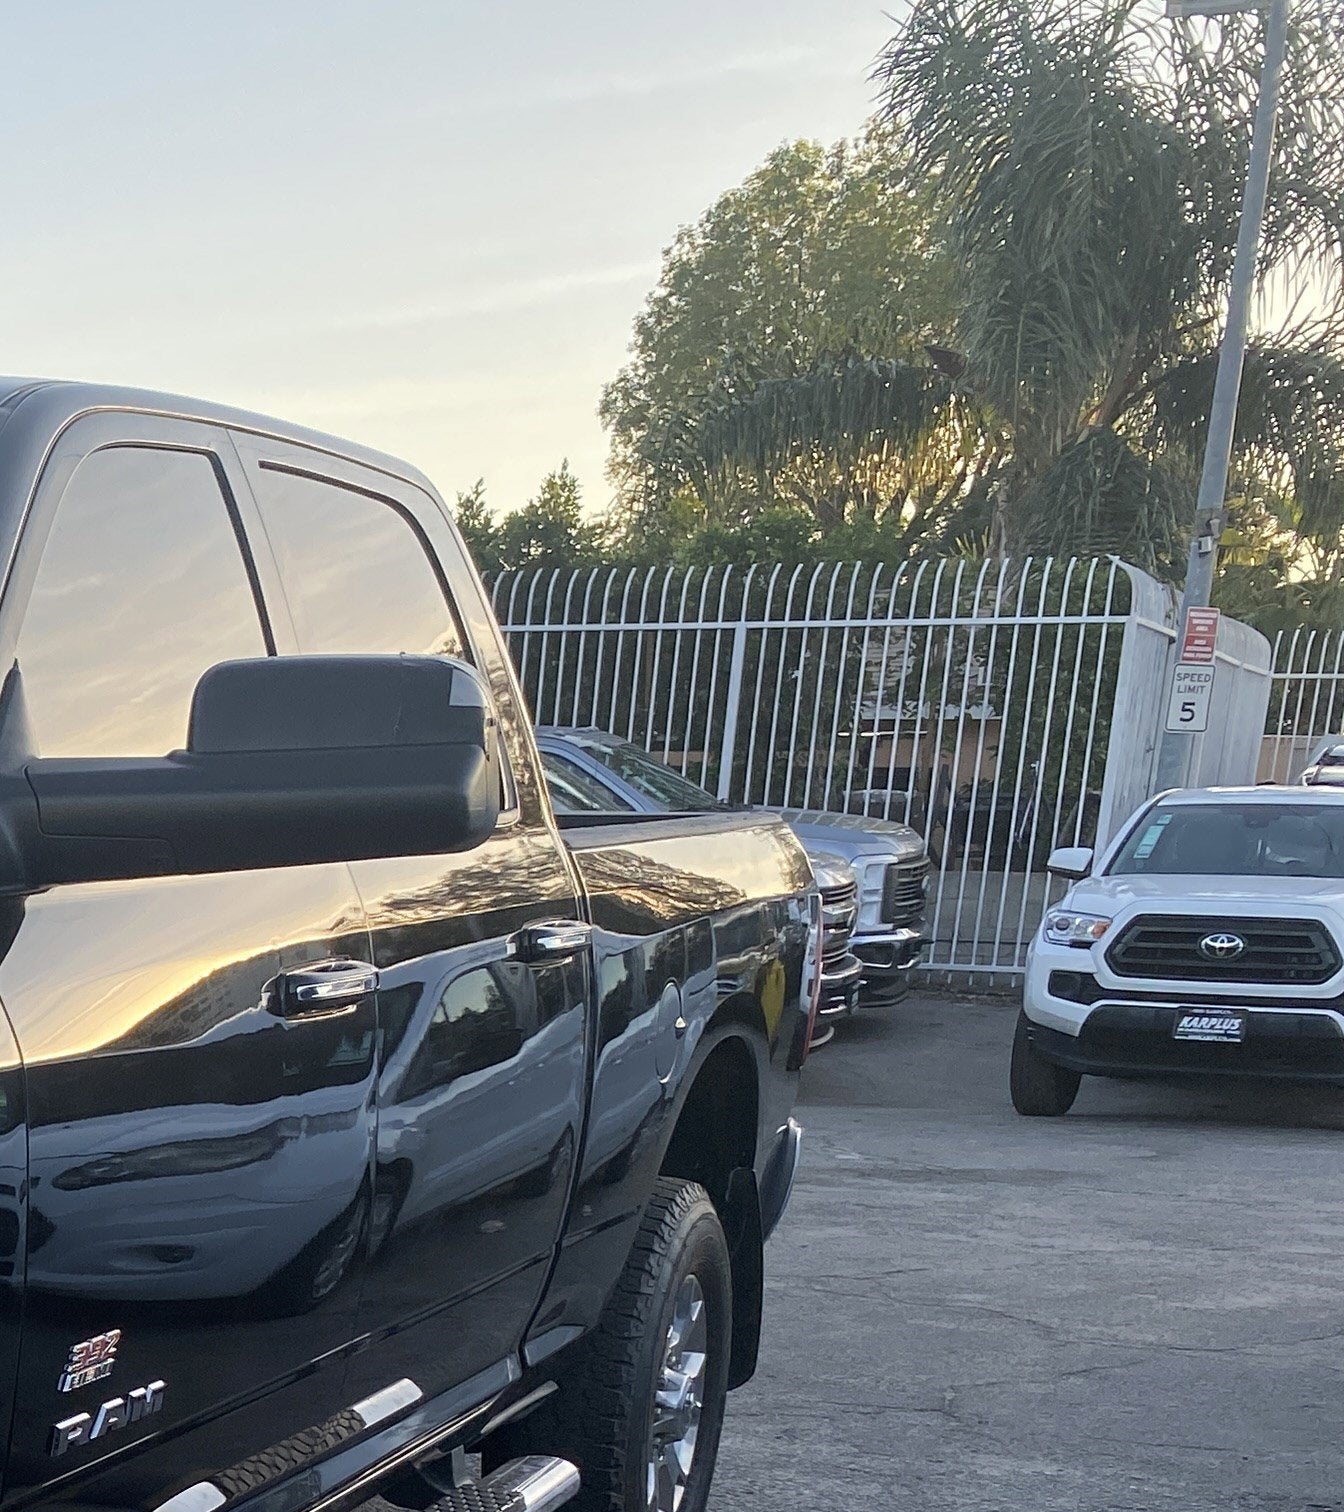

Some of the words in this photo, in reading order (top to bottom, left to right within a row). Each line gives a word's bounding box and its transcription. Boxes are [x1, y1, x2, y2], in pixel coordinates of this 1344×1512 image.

[1176, 672, 1211, 683] SPEED
[1177, 685, 1206, 695] LIMIT
[1179, 701, 1196, 722] 5
[1179, 1016, 1242, 1030] KARPLUS
[64, 1328, 121, 1373] 392
[50, 1379, 166, 1457] RAM
